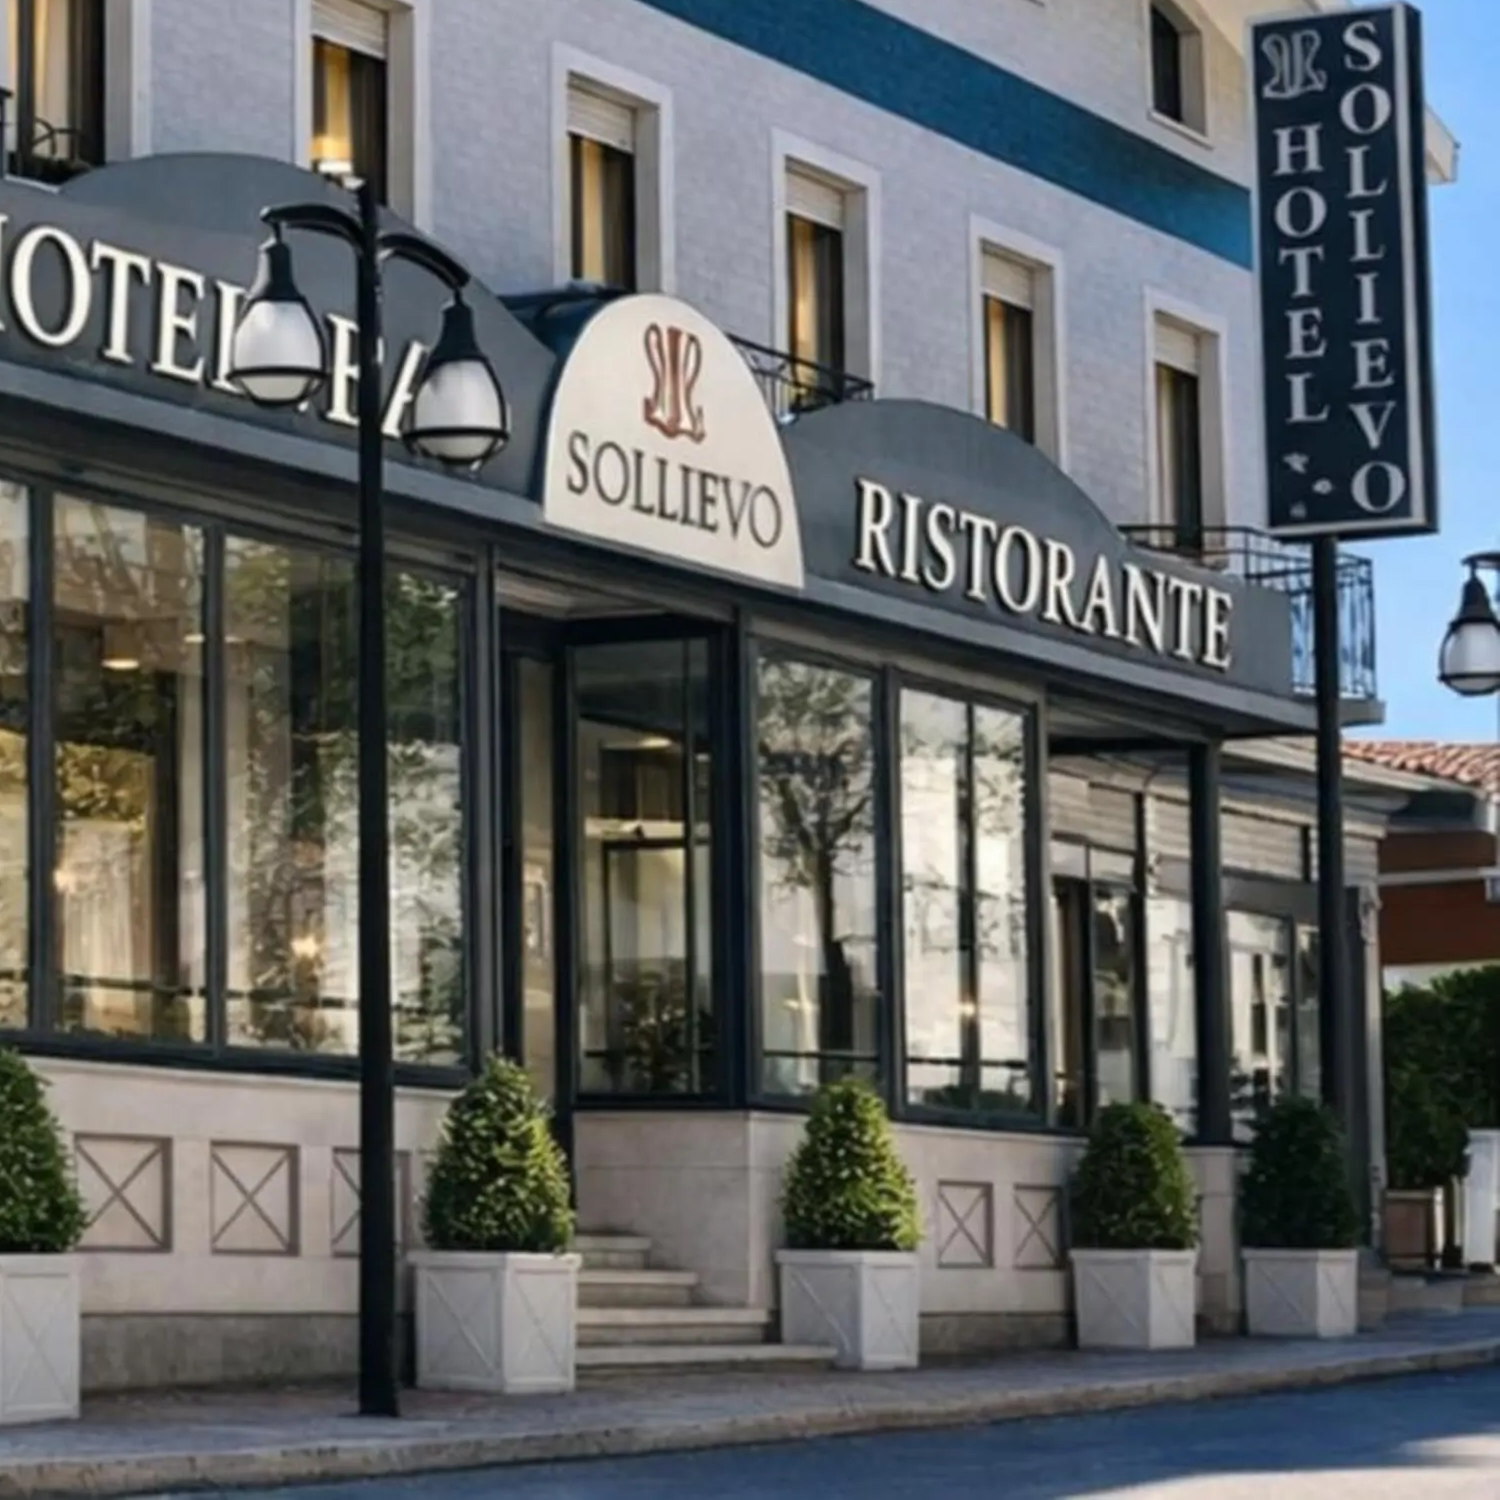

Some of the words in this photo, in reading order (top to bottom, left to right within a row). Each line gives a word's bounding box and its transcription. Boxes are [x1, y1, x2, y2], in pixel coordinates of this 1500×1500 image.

[1273, 122, 1329, 422] HOTEL
[1339, 20, 1406, 513] SOLLIEVO
[566, 431, 784, 550] SOLLIEVO
[854, 478, 1235, 671] RISTORANTE
